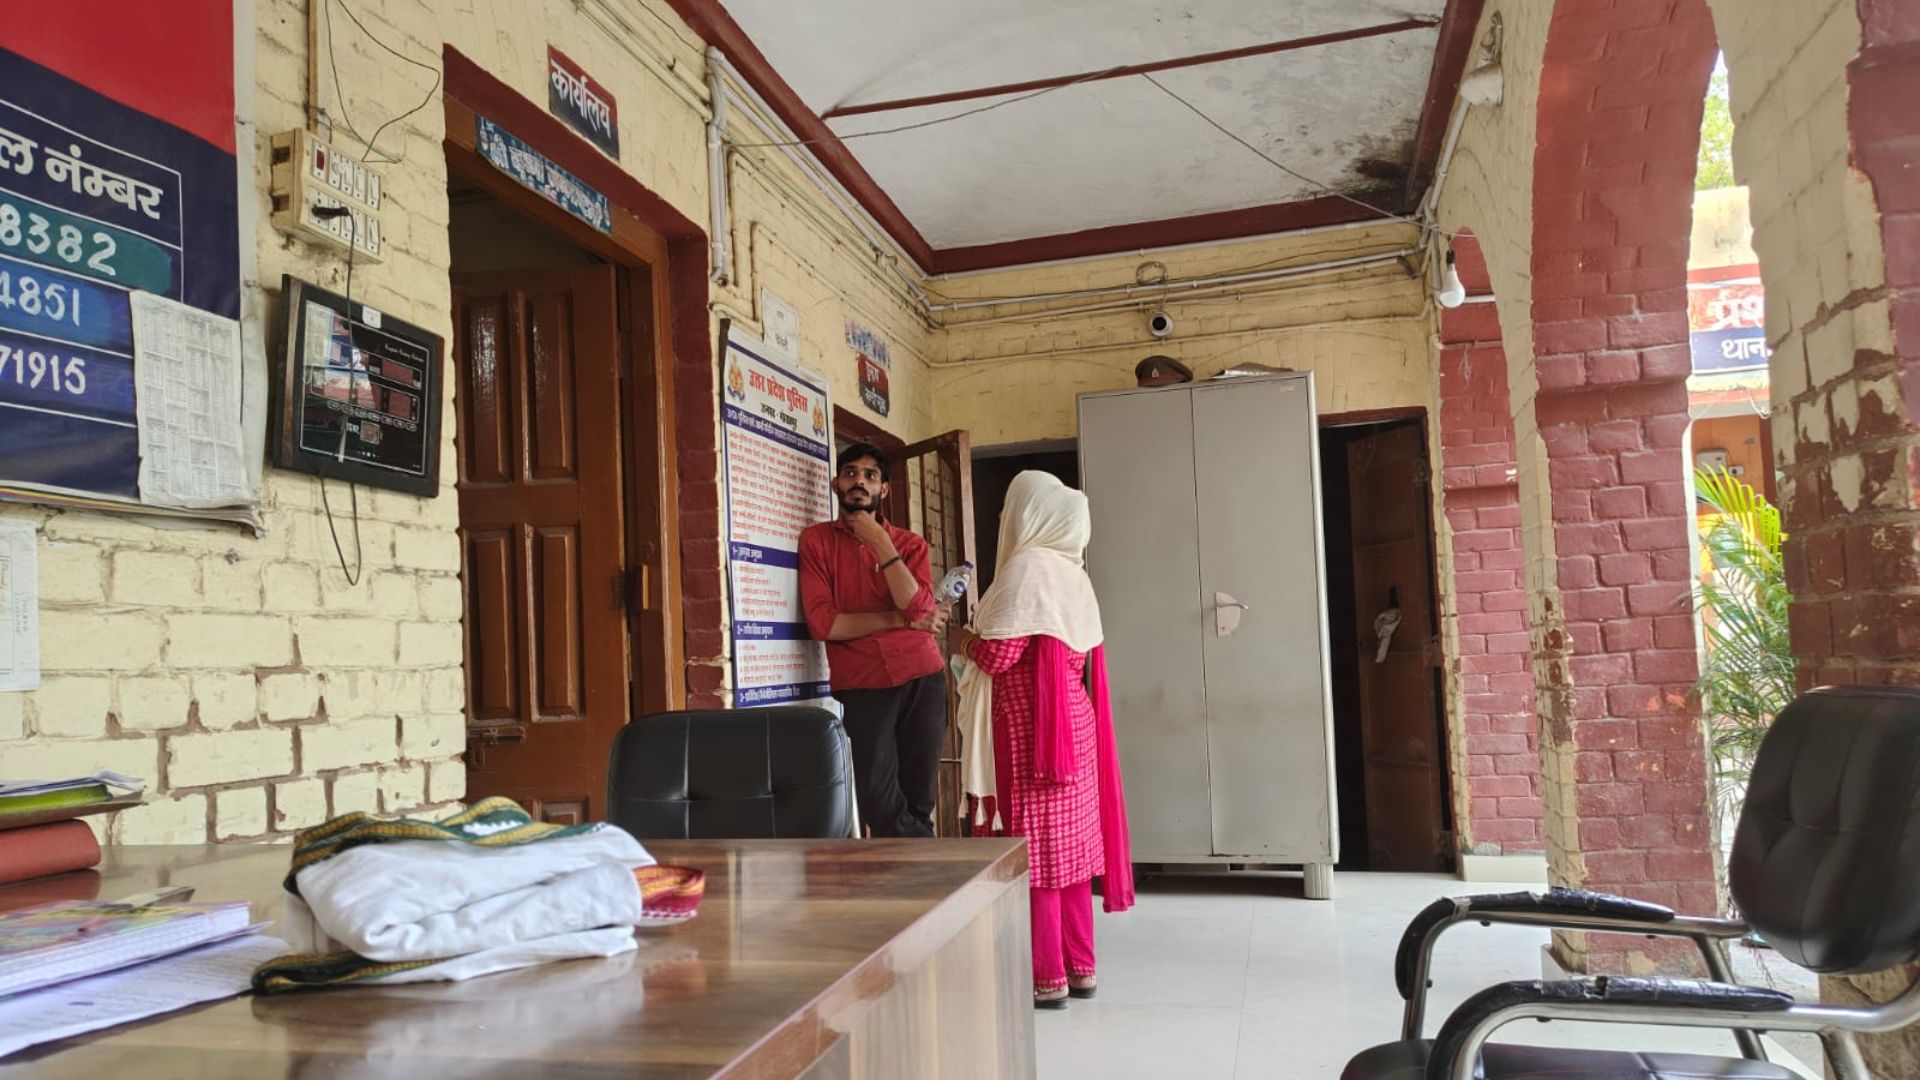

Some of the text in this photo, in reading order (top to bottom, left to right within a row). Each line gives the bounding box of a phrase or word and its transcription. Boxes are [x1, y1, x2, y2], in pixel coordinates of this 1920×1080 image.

[551, 59, 612, 139] कार्यालय
[45, 144, 164, 220] नंम्बर
[0, 203, 117, 276] 8382
[748, 368, 809, 414] उत्तर प्रदेश पुलिस
